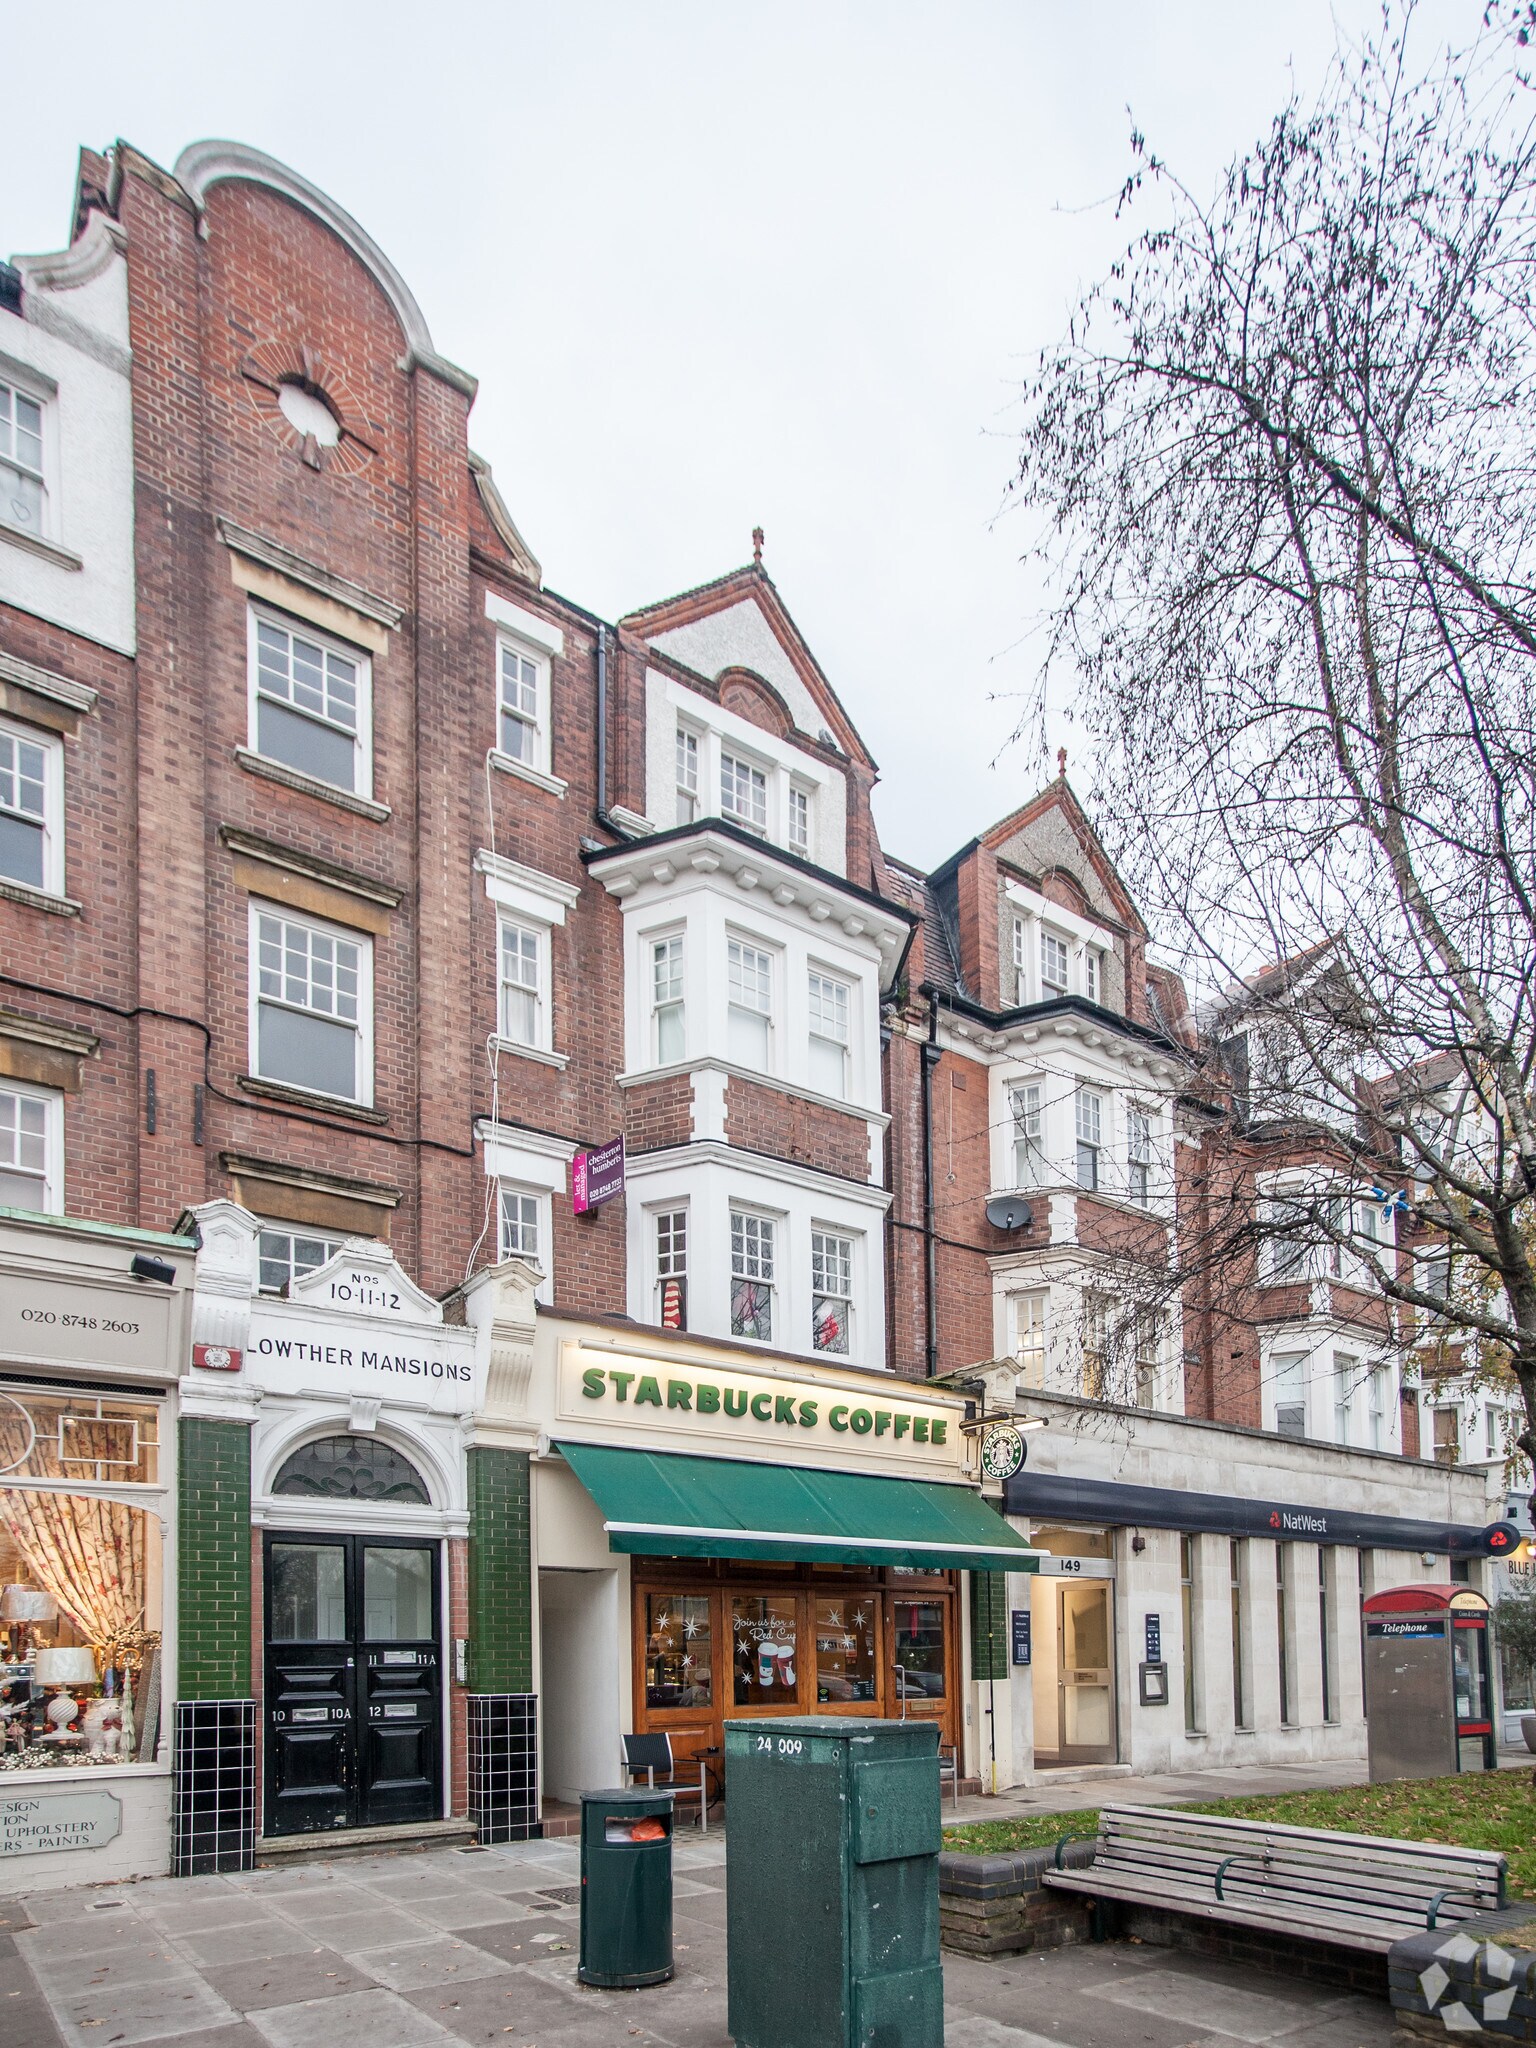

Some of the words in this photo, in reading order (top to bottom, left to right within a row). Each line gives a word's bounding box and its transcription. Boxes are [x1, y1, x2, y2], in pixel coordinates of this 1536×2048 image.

[589, 1144, 620, 1166] chesterton
[592, 1154, 621, 1175] humberts
[590, 1189, 599, 1198] 020
[21, 1308, 56, 1324] 020
[61, 1314, 98, 1329] 8748
[102, 1319, 139, 1334] 2603
[361, 1351, 472, 1382] MANSIONS
[581, 1367, 819, 1428] STARBUCKS
[828, 1405, 947, 1445] COFFEE
[984, 1429, 1021, 1454] STARBUCKS
[987, 1460, 1017, 1477] COFFEE
[1283, 1512, 1327, 1532] NatWest
[1061, 1559, 1081, 1572] 149
[1508, 1560, 1529, 1576] BLUE
[732, 1614, 756, 1630] Join
[771, 1615, 786, 1628] for
[1382, 1623, 1428, 1634] Telephone
[749, 1628, 773, 1641] Red
[368, 1654, 377, 1665] 11
[417, 1654, 436, 1665] 11A
[272, 1710, 285, 1721] 10
[331, 1708, 351, 1719] 10A
[369, 1706, 381, 1717] 12
[757, 1736, 772, 1751] 24
[778, 1738, 802, 1754] 009
[6, 1821, 98, 1838] UPHOLSTERY
[39, 1834, 90, 1848] PAINTS
